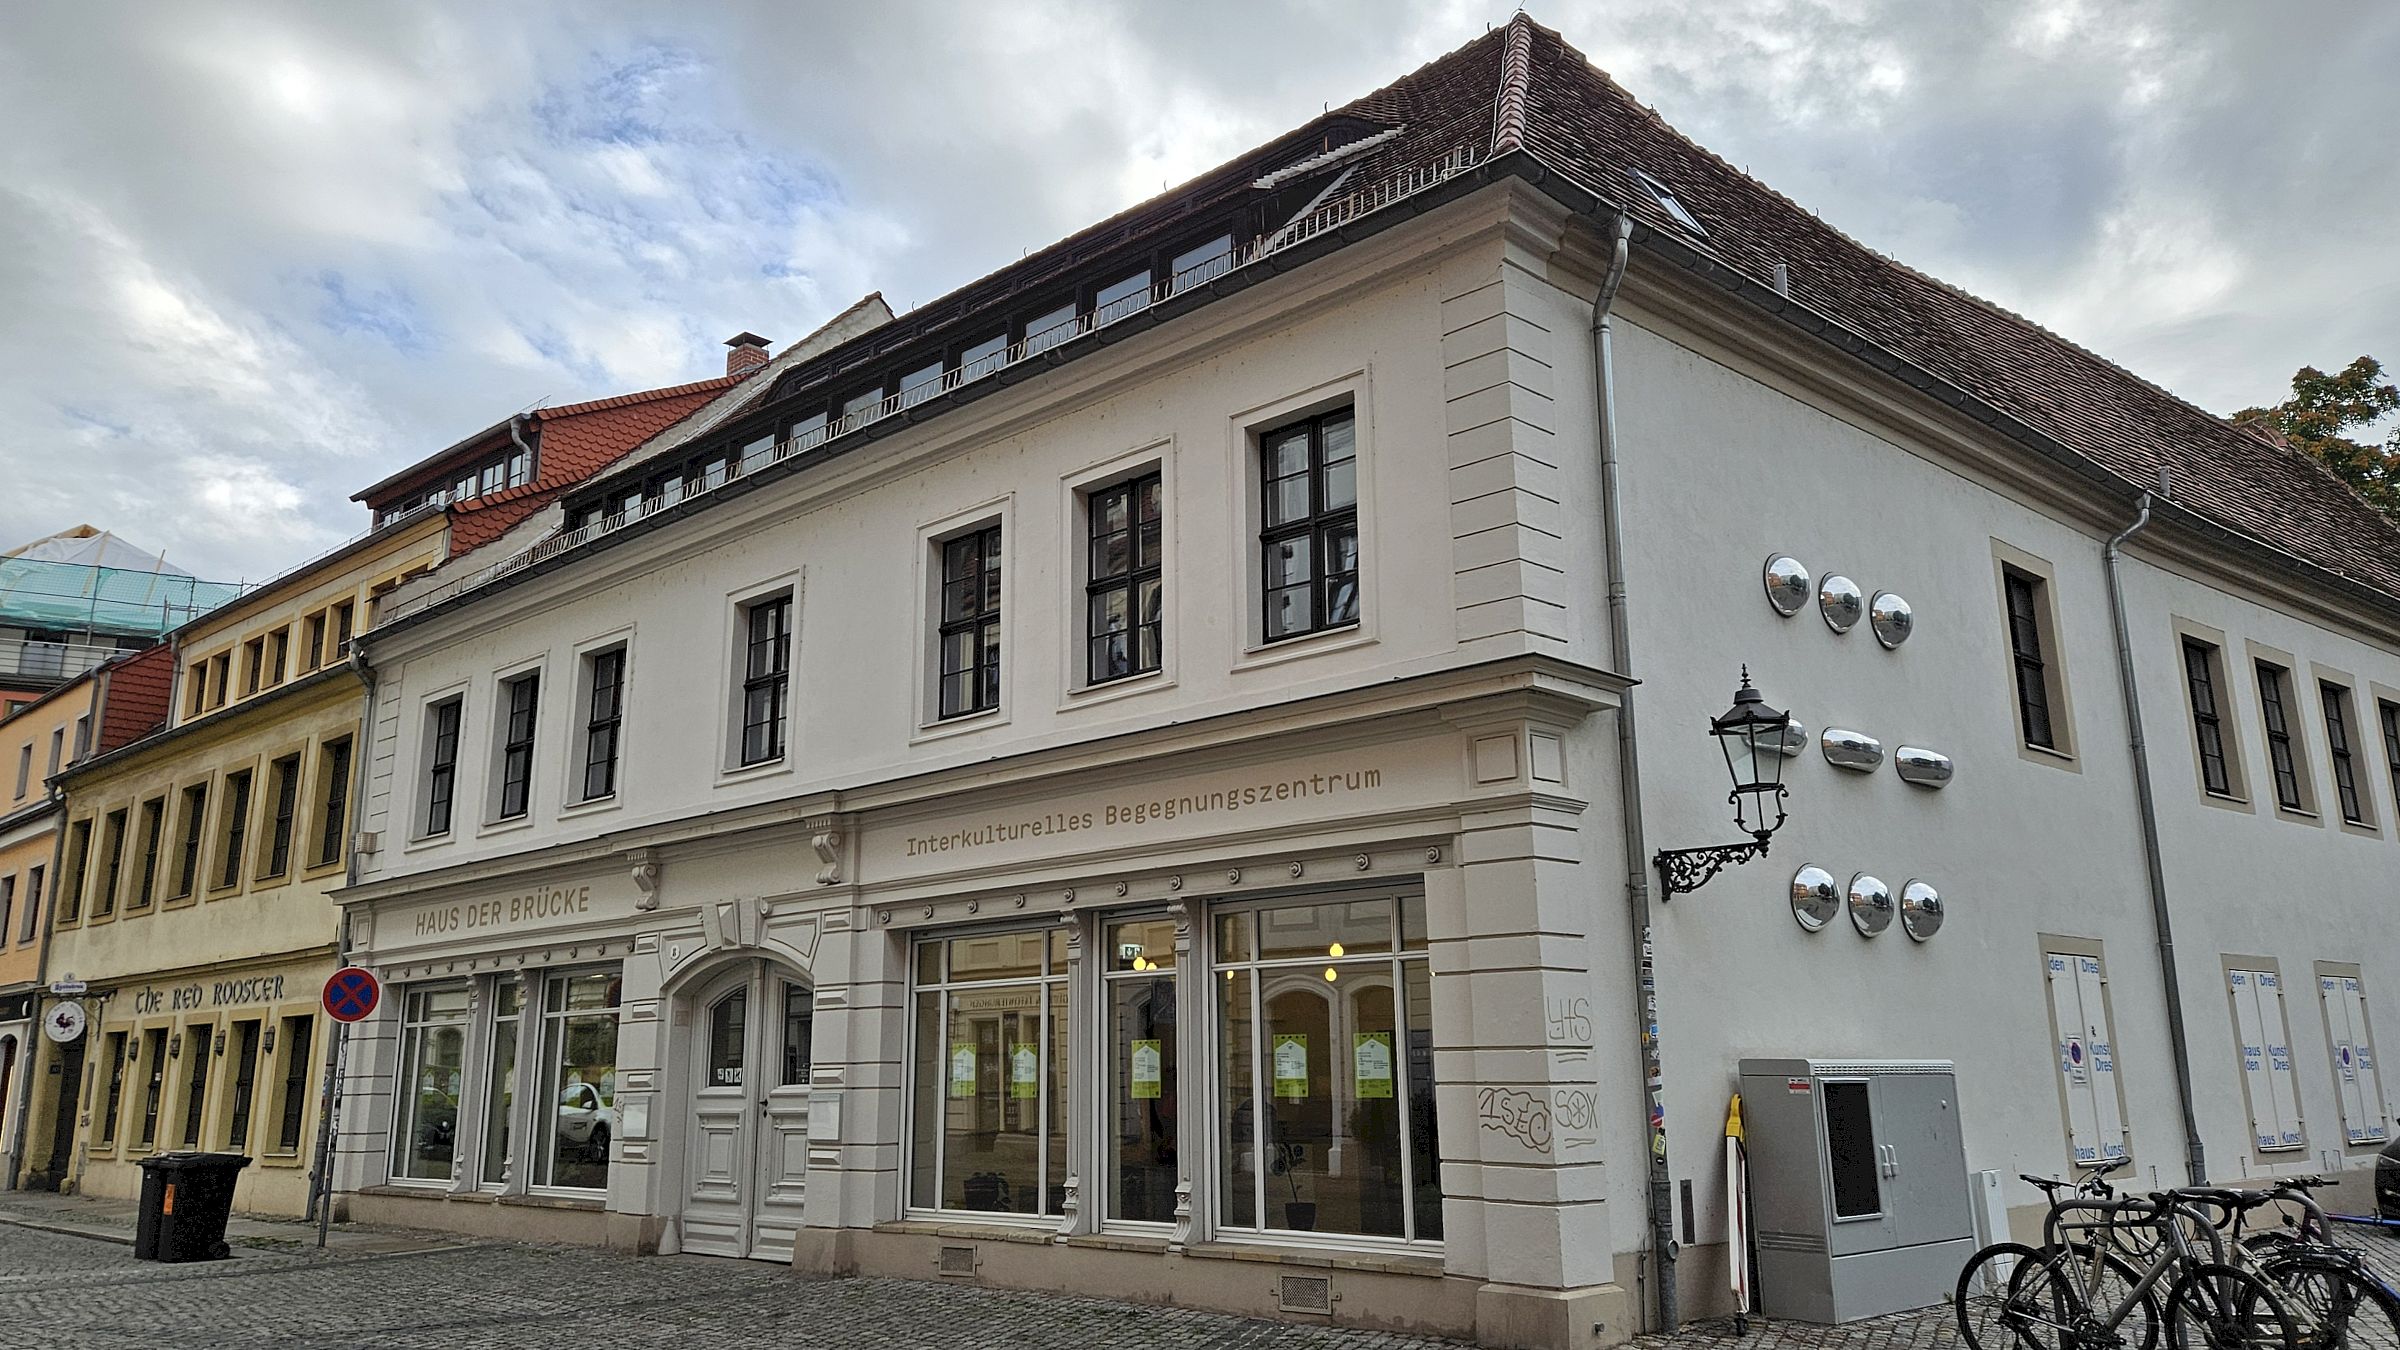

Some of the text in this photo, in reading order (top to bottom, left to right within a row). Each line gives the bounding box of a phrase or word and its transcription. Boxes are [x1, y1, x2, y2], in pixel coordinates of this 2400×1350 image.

[907, 769, 1381, 857] Interkulturelles Begegnungszentrum
[415, 886, 590, 936] HAUS DER BRÜCKE
[2050, 956, 2098, 973] den Dres
[2232, 973, 2276, 987] den Dres
[2323, 979, 2335, 990] den
[172, 983, 203, 1010] RED
[213, 975, 284, 1007] ROOSTER
[2090, 1042, 2111, 1056] Kunst
[2269, 1044, 2288, 1057] Kunst
[2095, 1057, 2112, 1072] Dres
[2245, 1058, 2289, 1071] den Dres
[2257, 1130, 2301, 1145] haus Kunst
[2074, 1142, 2125, 1160] haus Kunst
